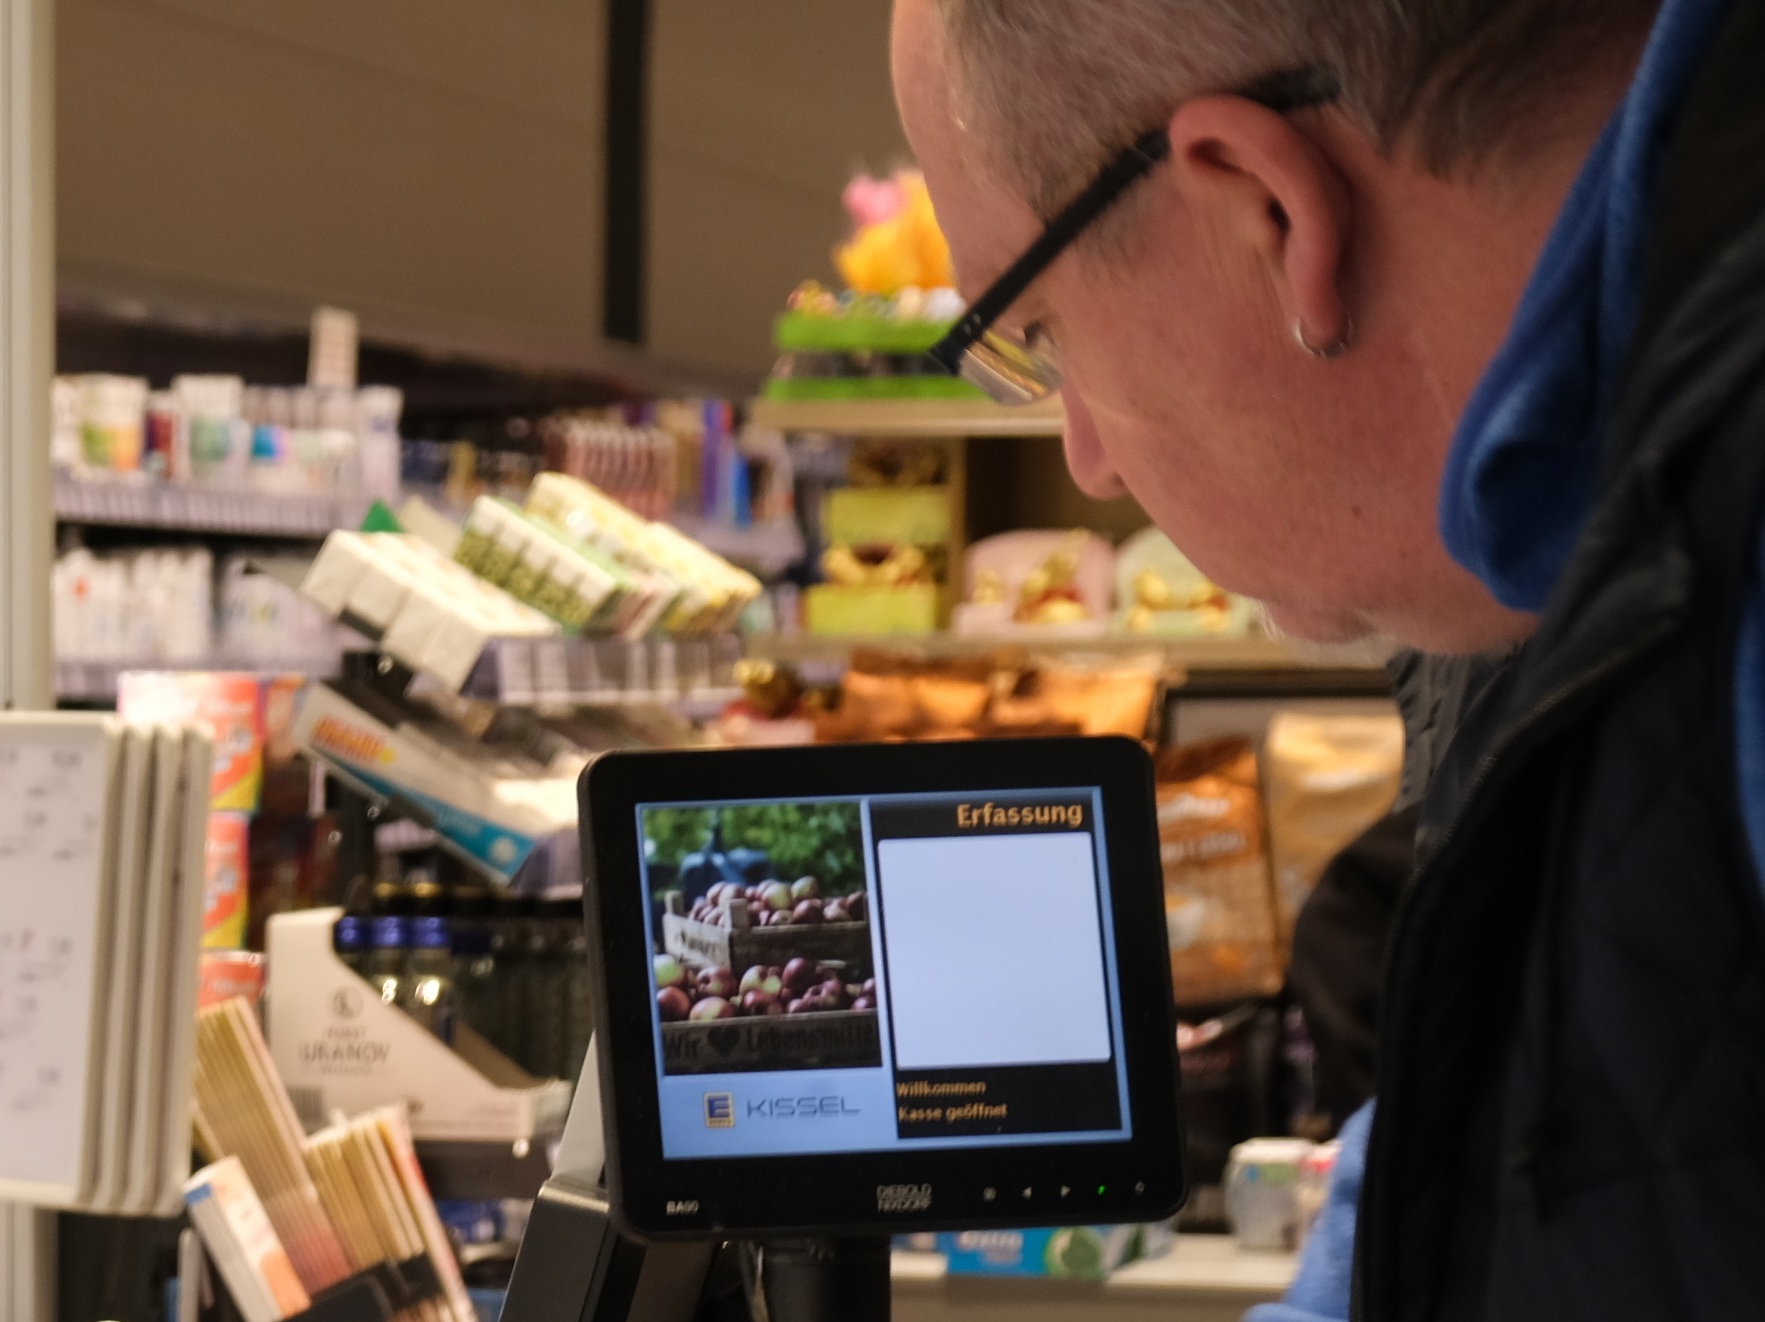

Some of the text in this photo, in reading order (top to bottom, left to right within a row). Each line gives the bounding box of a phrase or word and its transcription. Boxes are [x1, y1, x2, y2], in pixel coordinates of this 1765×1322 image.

[957, 802, 1083, 828] Erfassung
[896, 1080, 986, 1097] Willkommen
[747, 1095, 860, 1118] KISSEL
[898, 1103, 1008, 1123] Kasse geöffnet
